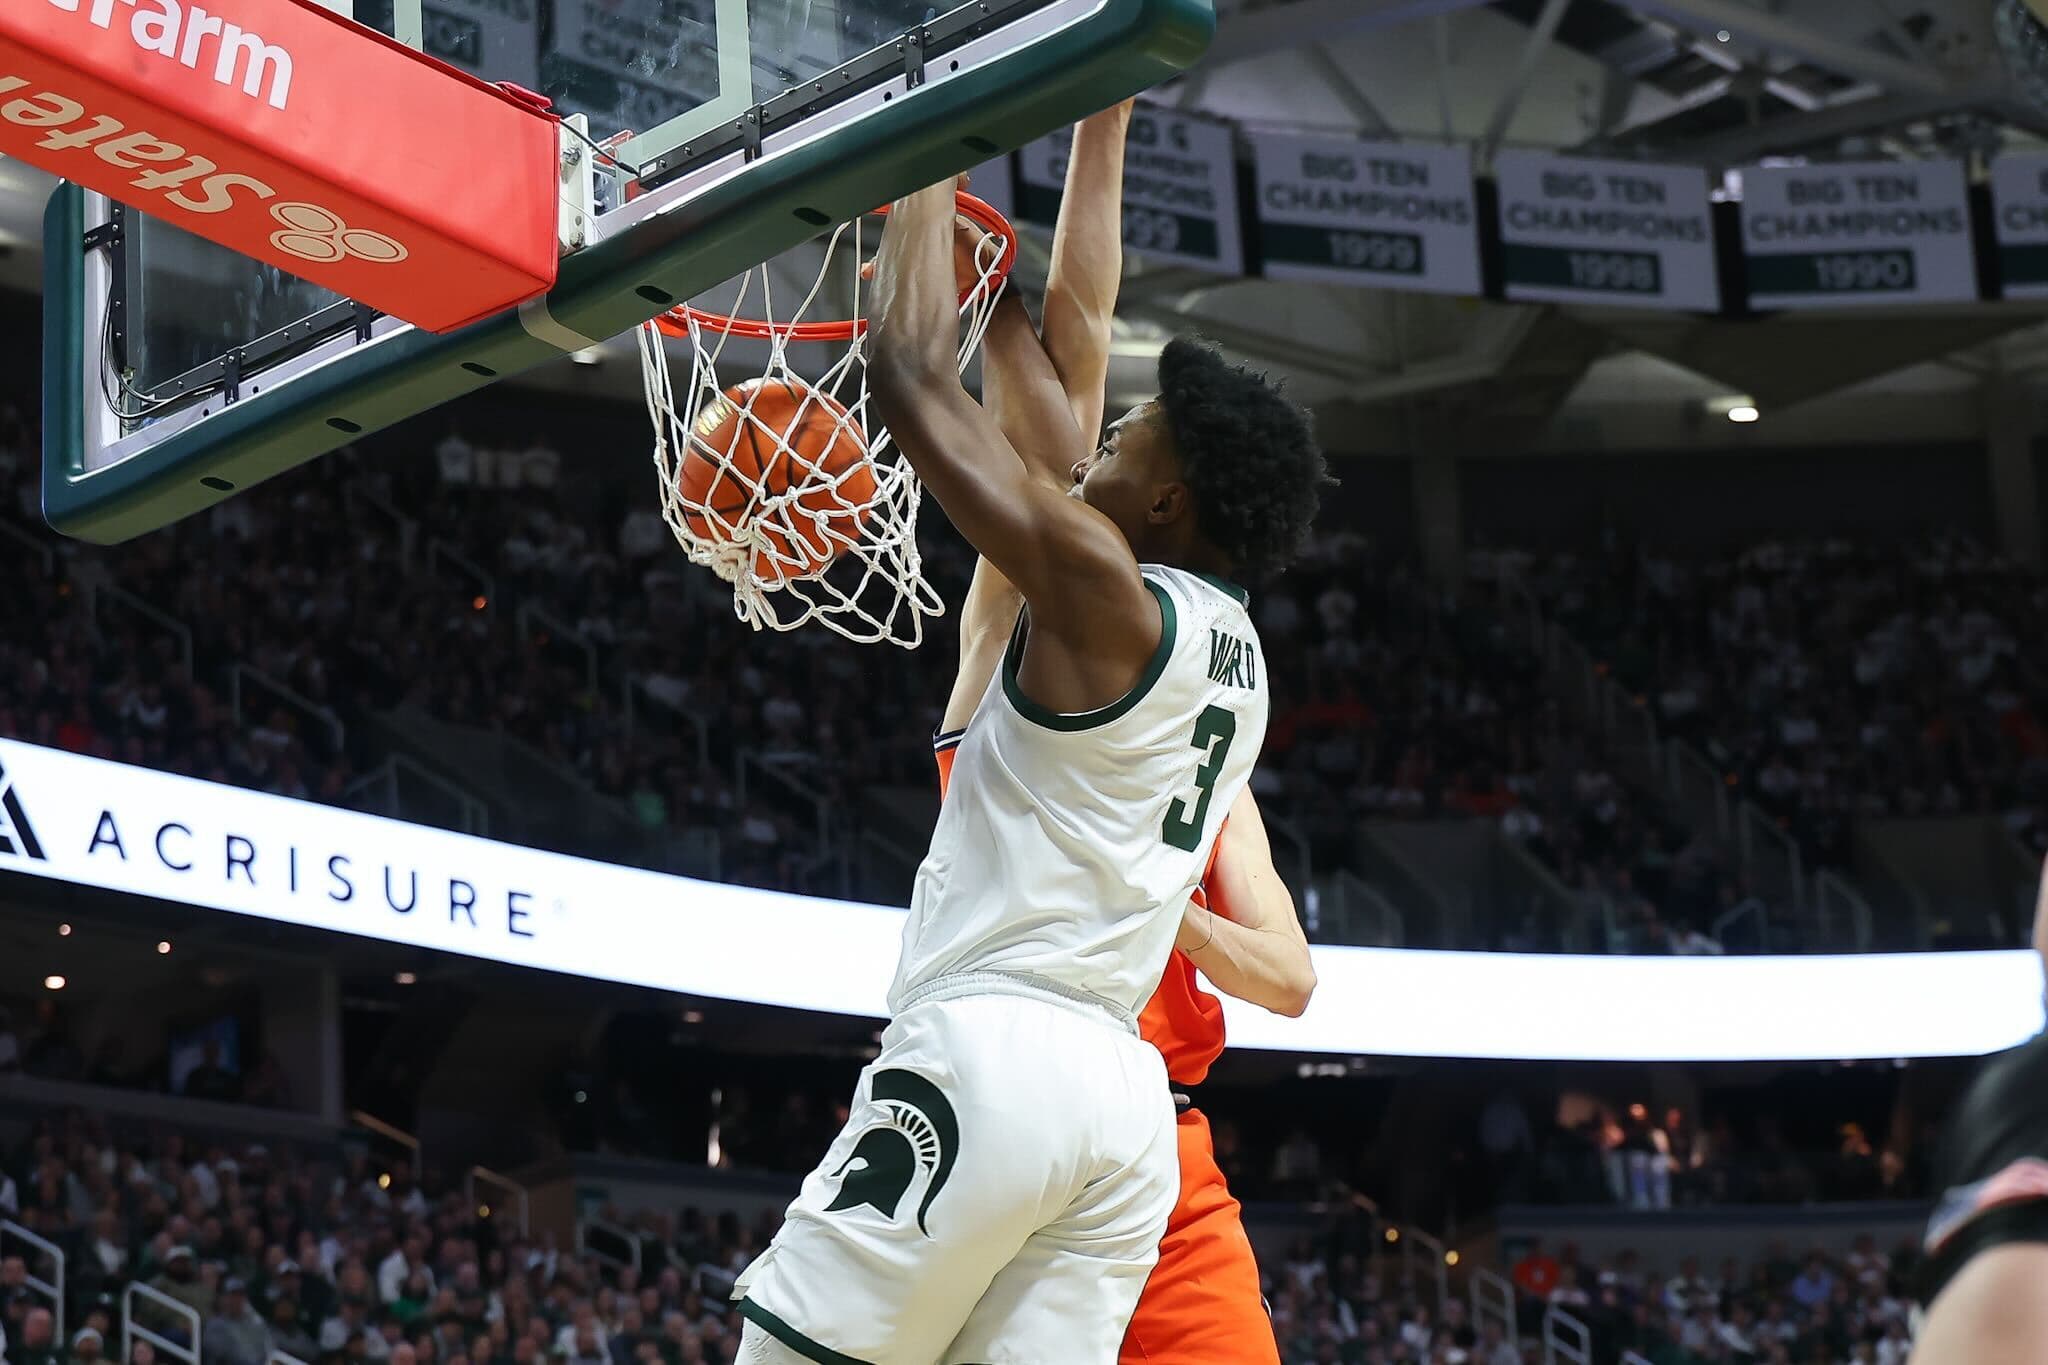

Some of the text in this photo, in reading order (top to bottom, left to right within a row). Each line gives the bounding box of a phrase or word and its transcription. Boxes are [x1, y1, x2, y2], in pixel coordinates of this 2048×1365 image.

[1301, 153, 1428, 187] BIG TEN
[1541, 170, 1666, 204] BIG TEN
[1265, 181, 1470, 226] CHAMPIONS
[1786, 175, 1919, 205] BIG TEN
[1506, 203, 1706, 243] CHAMPIONS
[1750, 208, 1962, 241] CHAMPIONS
[1331, 231, 1417, 270] 1999
[1816, 254, 1910, 289] 1990
[1207, 628, 1255, 690] WARD
[1162, 704, 1236, 852] 3
[88, 809, 536, 938] ACRISURE
